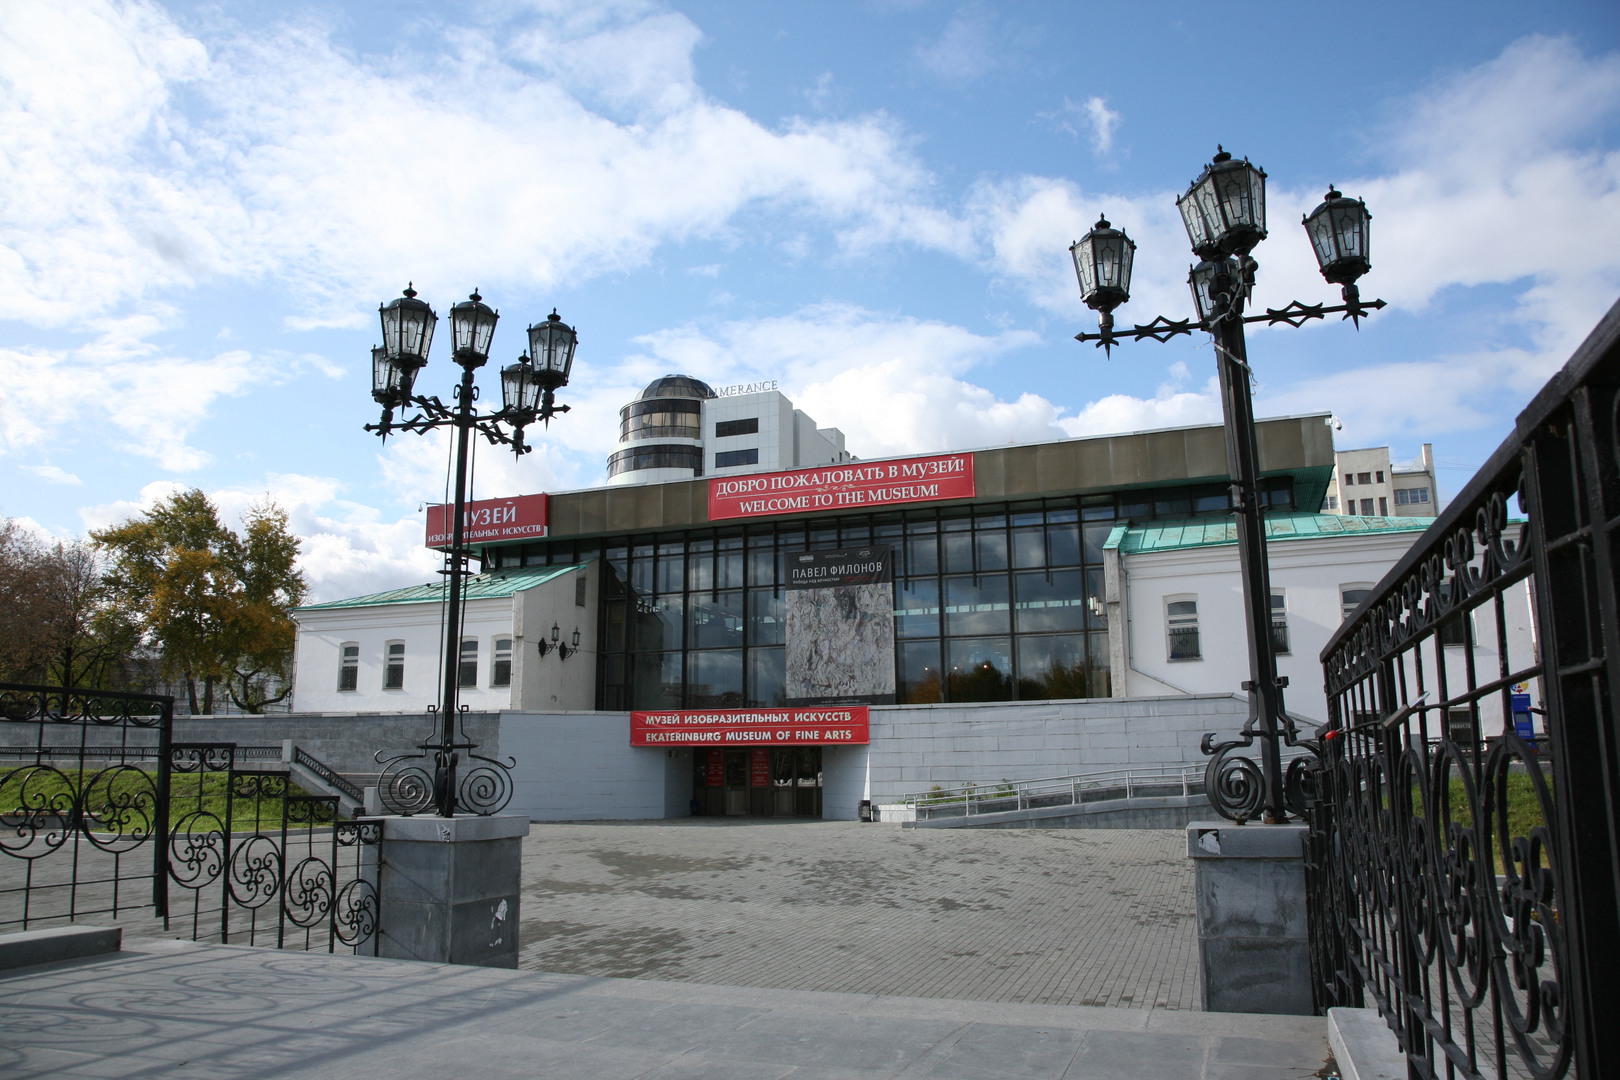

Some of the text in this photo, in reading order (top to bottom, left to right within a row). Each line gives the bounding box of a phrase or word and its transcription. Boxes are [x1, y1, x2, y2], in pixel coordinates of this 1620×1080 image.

[706, 380, 778, 398] LIMERANCE
[716, 456, 965, 497] ДОБРО ПОЖАЛОВАТЬ В МУЗЕЙ!
[739, 484, 939, 513] WELCOME TO THE MUSEUM!
[502, 524, 541, 535] ИСКУССТВ
[792, 561, 882, 579] ПАВЕЛ ФИЛОНОВ
[645, 712, 852, 724] МУЗЕЙ ИЗОБРАЗИТЕЛЬНЫХ ИСКУССТВ
[646, 730, 852, 741] EKATERINBURG MUSEUM OF FINE ARTS
